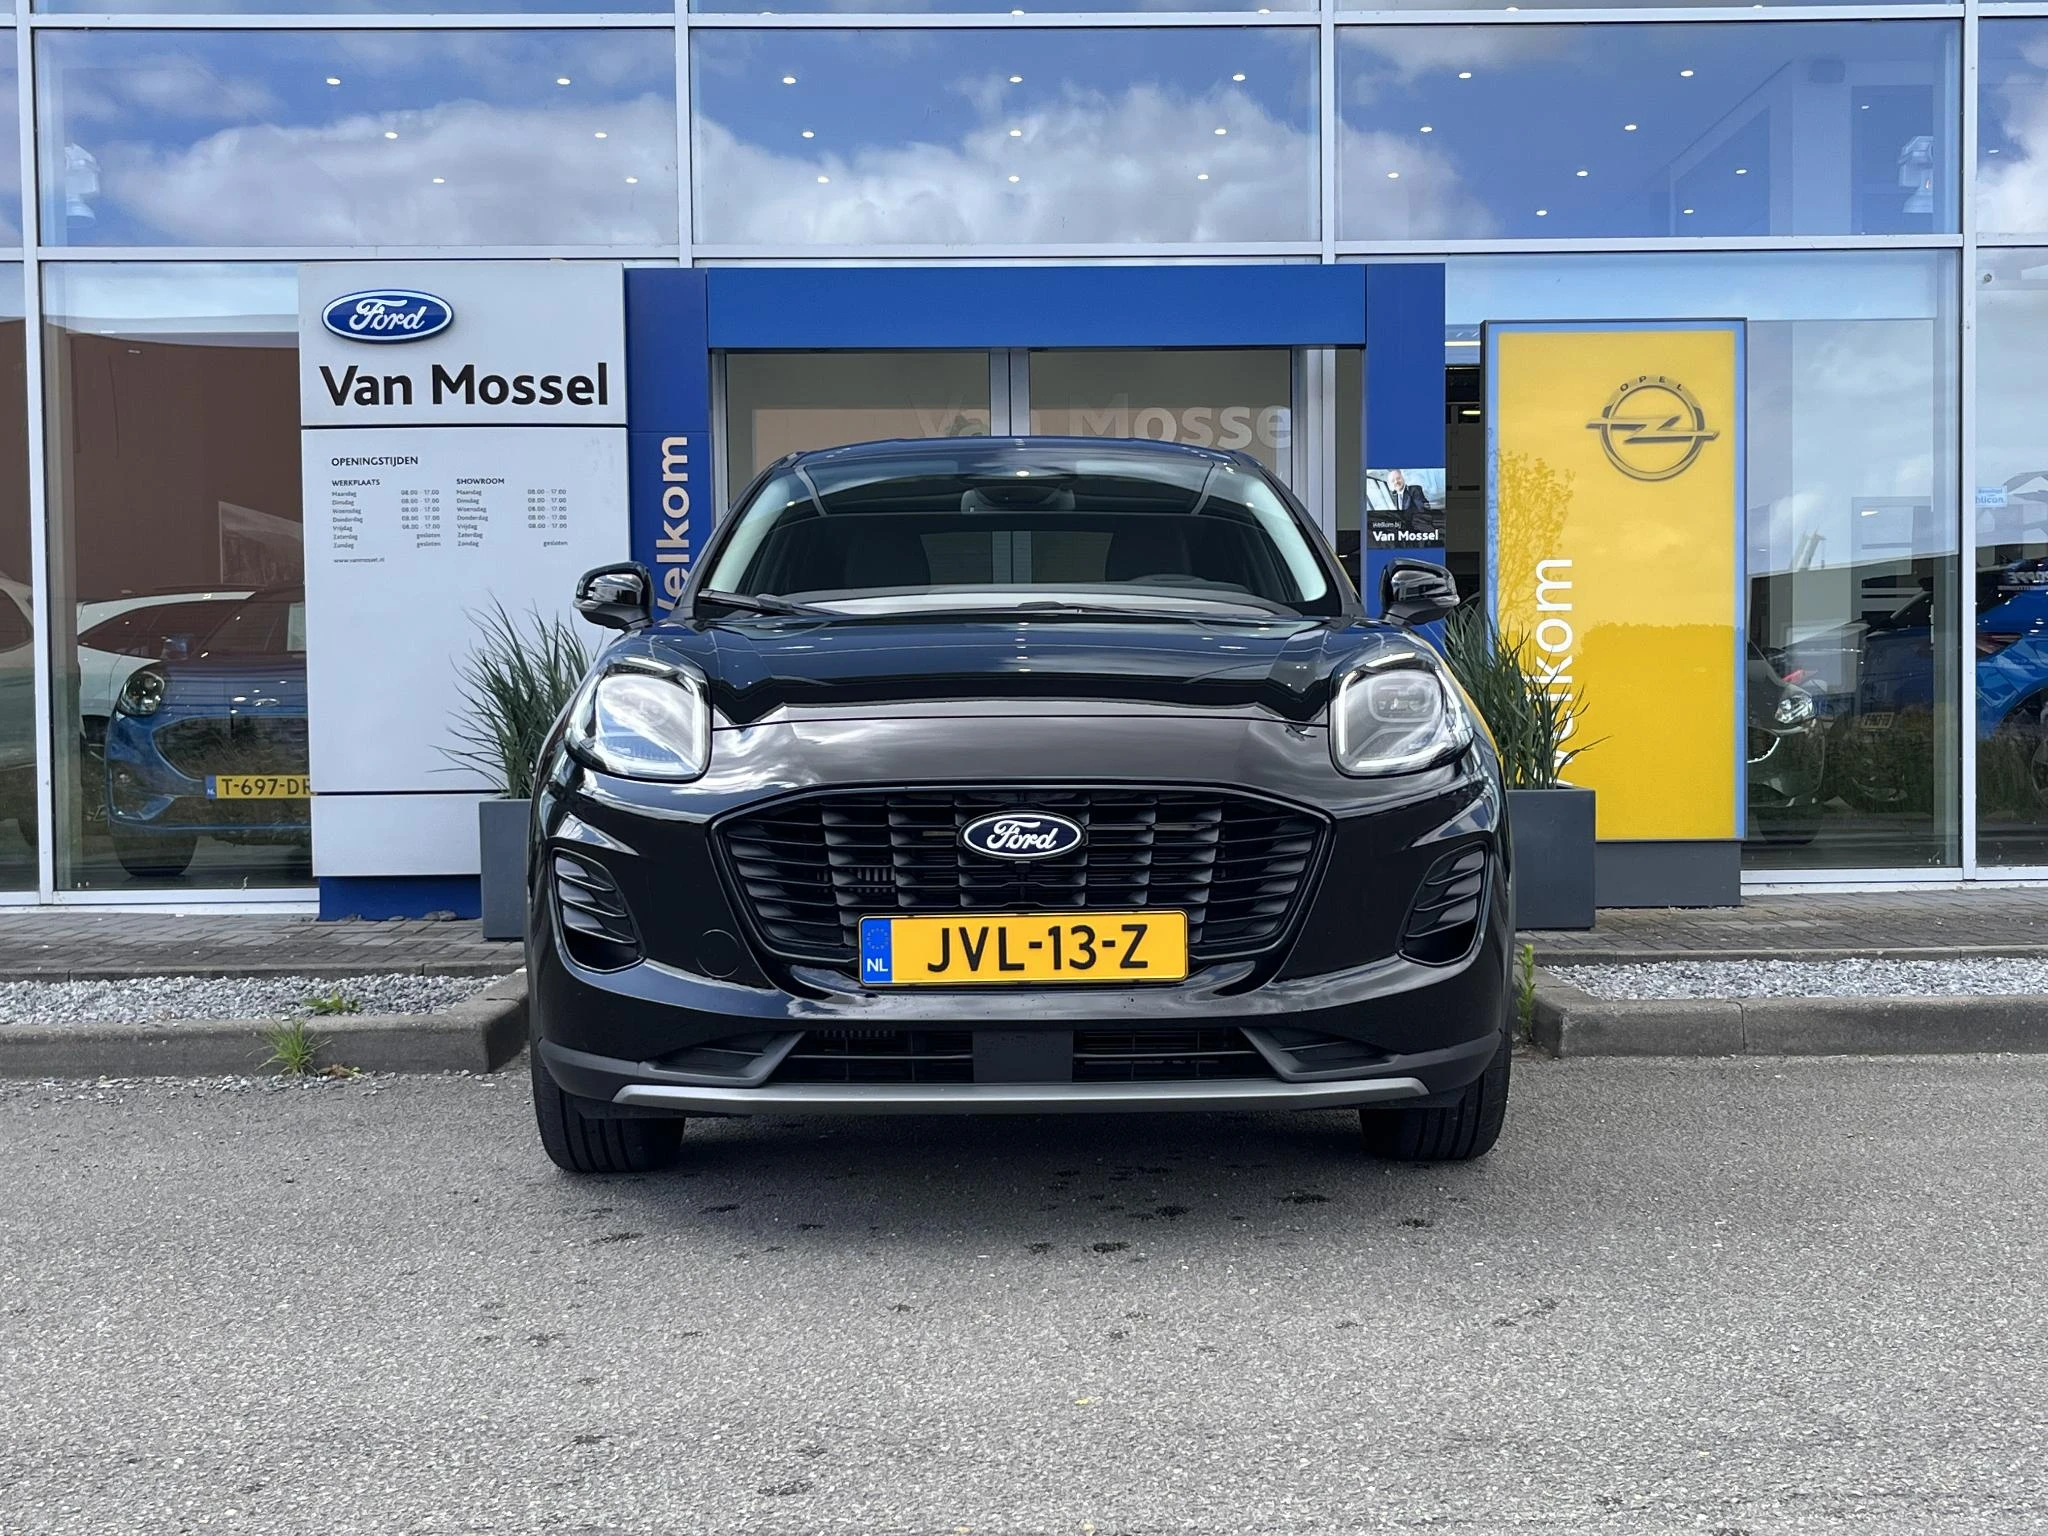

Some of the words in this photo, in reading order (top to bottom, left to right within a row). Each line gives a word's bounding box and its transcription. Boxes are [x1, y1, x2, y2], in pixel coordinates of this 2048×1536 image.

[349, 299, 427, 331] Ford
[319, 365, 412, 406] Van
[432, 362, 608, 406] Mossel
[1620, 375, 1683, 392] OPEL
[331, 456, 418, 466] OPENINGSTIJDEN
[656, 436, 690, 611] elkom
[1373, 531, 1394, 542] Van
[1398, 529, 1439, 542] Mossel
[986, 819, 1057, 851] Ford
[927, 923, 1149, 973] JVL-13-Z
[867, 958, 889, 973] NL
